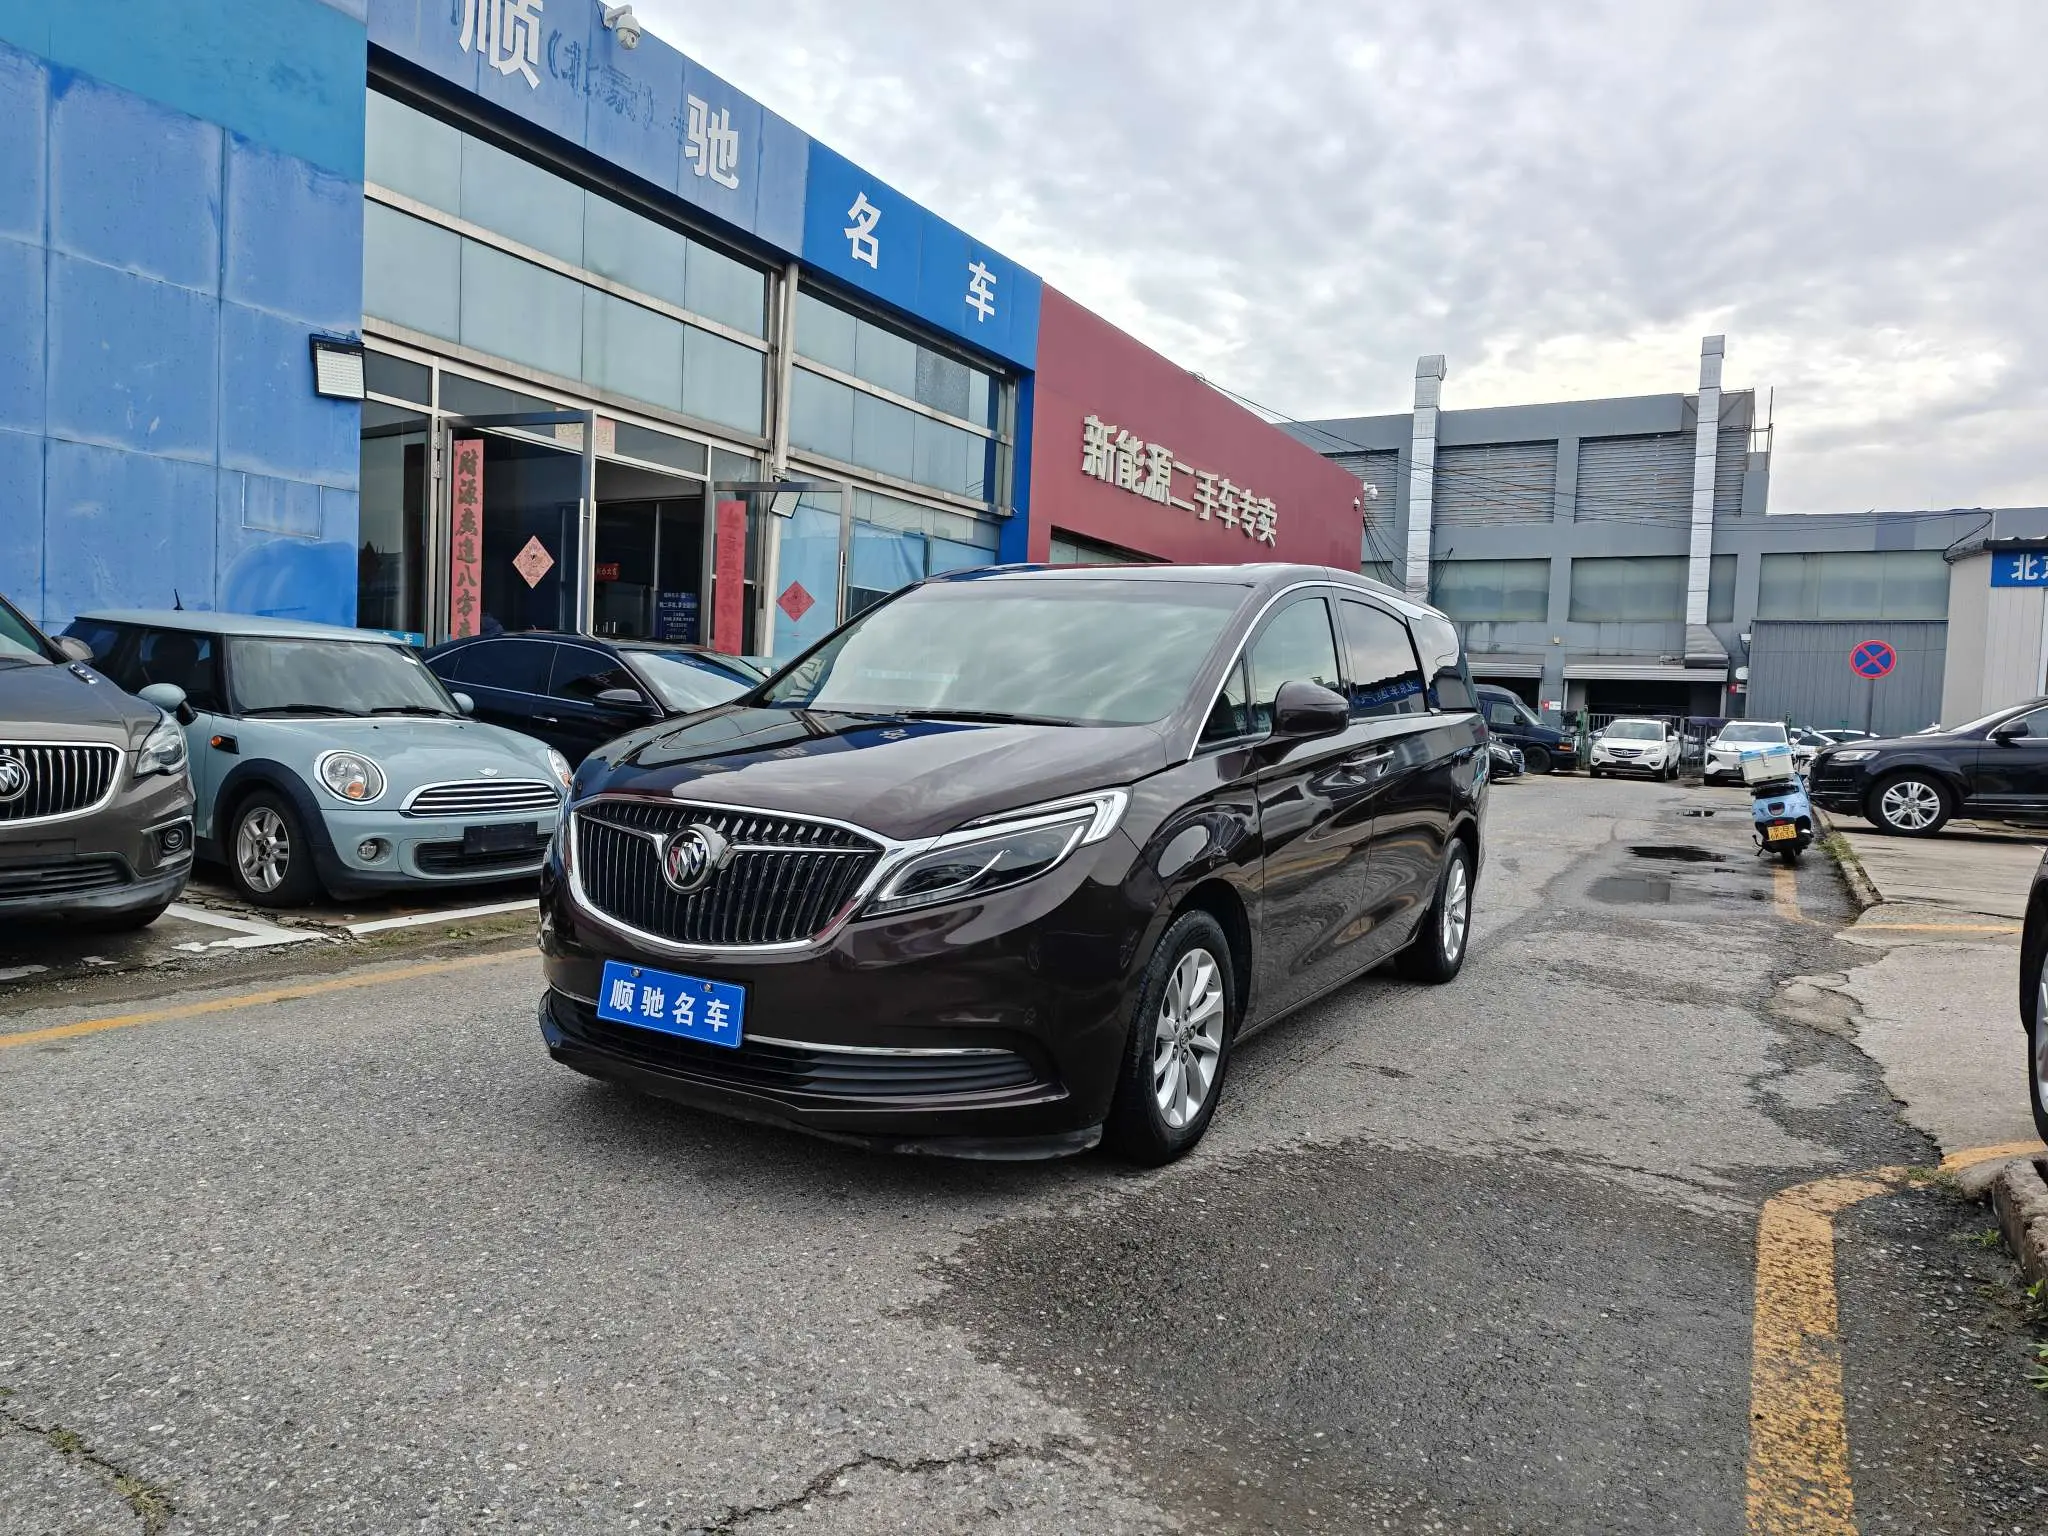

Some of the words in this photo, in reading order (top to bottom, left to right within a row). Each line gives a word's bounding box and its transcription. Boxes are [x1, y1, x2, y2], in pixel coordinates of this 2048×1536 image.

[1082, 415, 1277, 547] 新能源二手车专卖
[609, 979, 729, 1032] 顺驰名车
